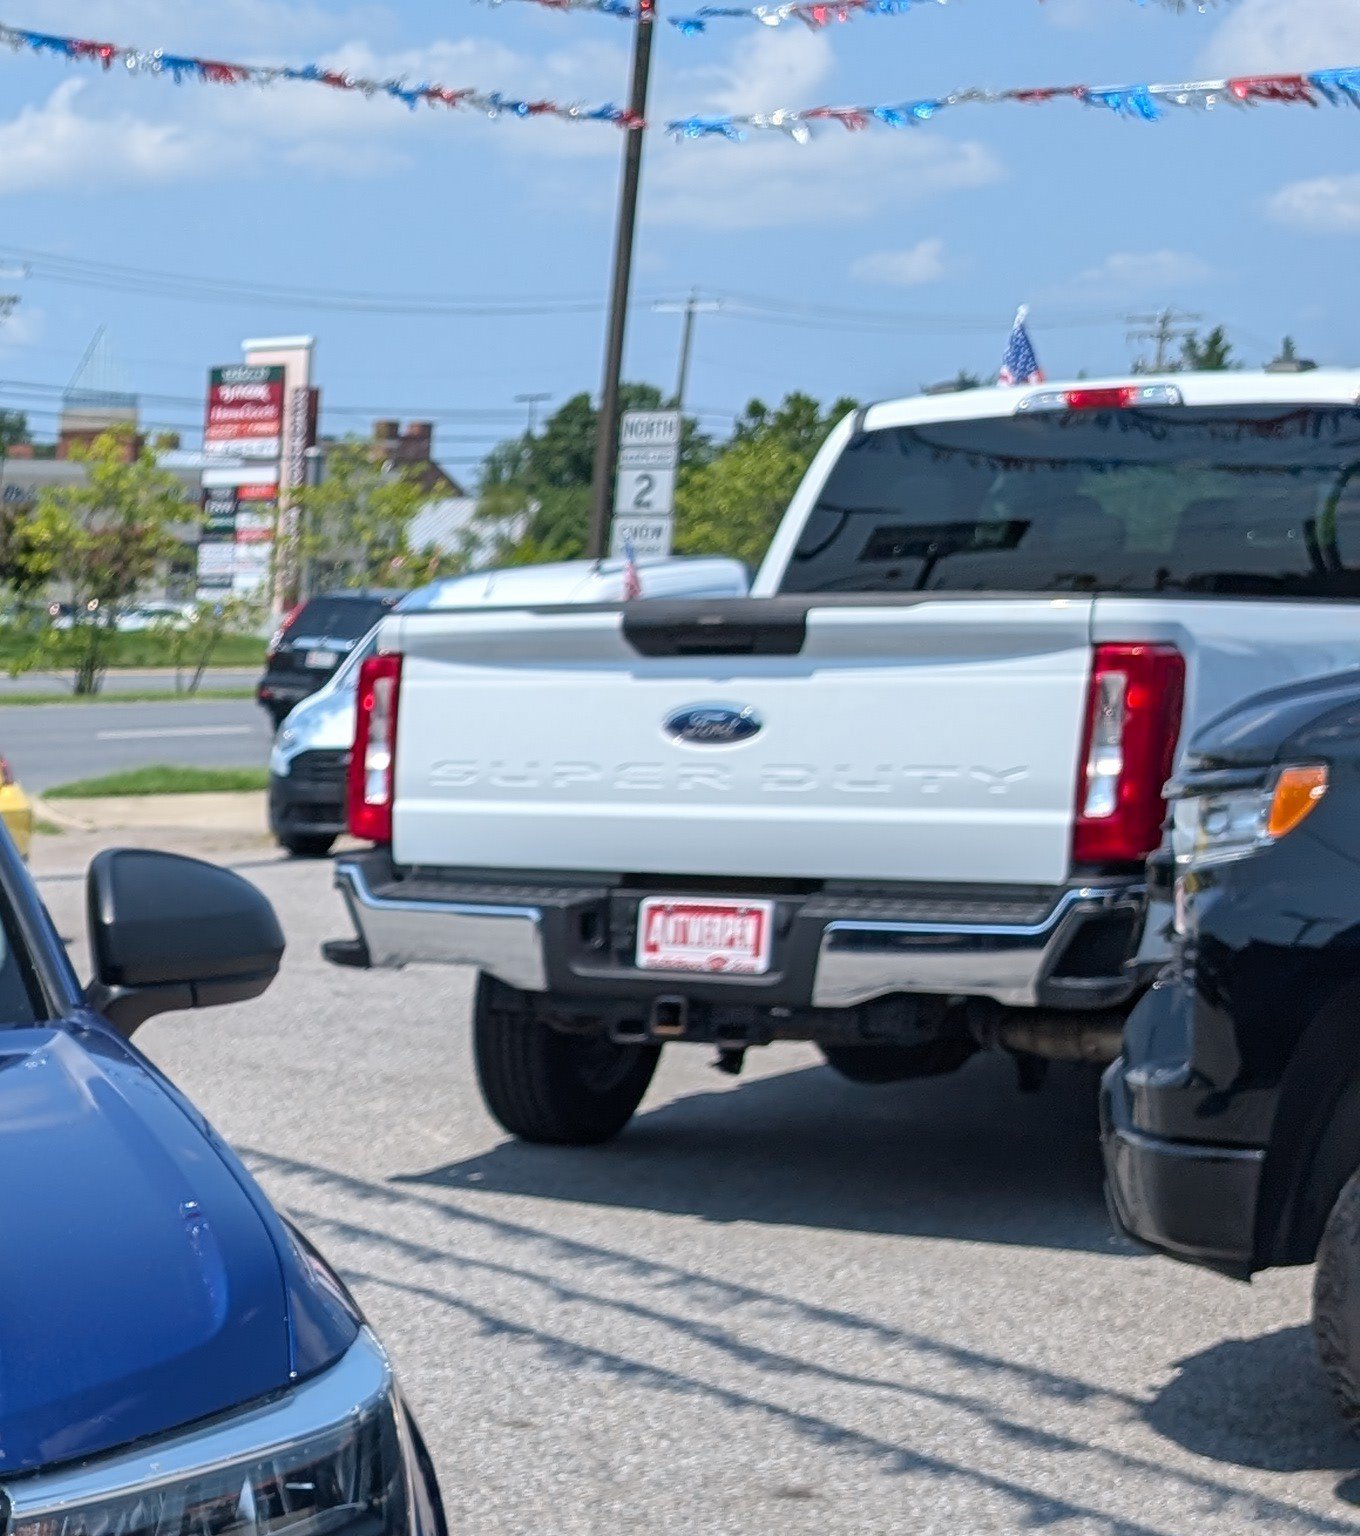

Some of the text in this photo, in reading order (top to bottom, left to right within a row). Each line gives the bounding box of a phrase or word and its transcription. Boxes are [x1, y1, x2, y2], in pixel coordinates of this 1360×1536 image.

[624, 420, 673, 439] NORTH
[633, 473, 655, 508] 2
[679, 710, 743, 738] Ford
[429, 760, 1029, 796] SUPER DUTY
